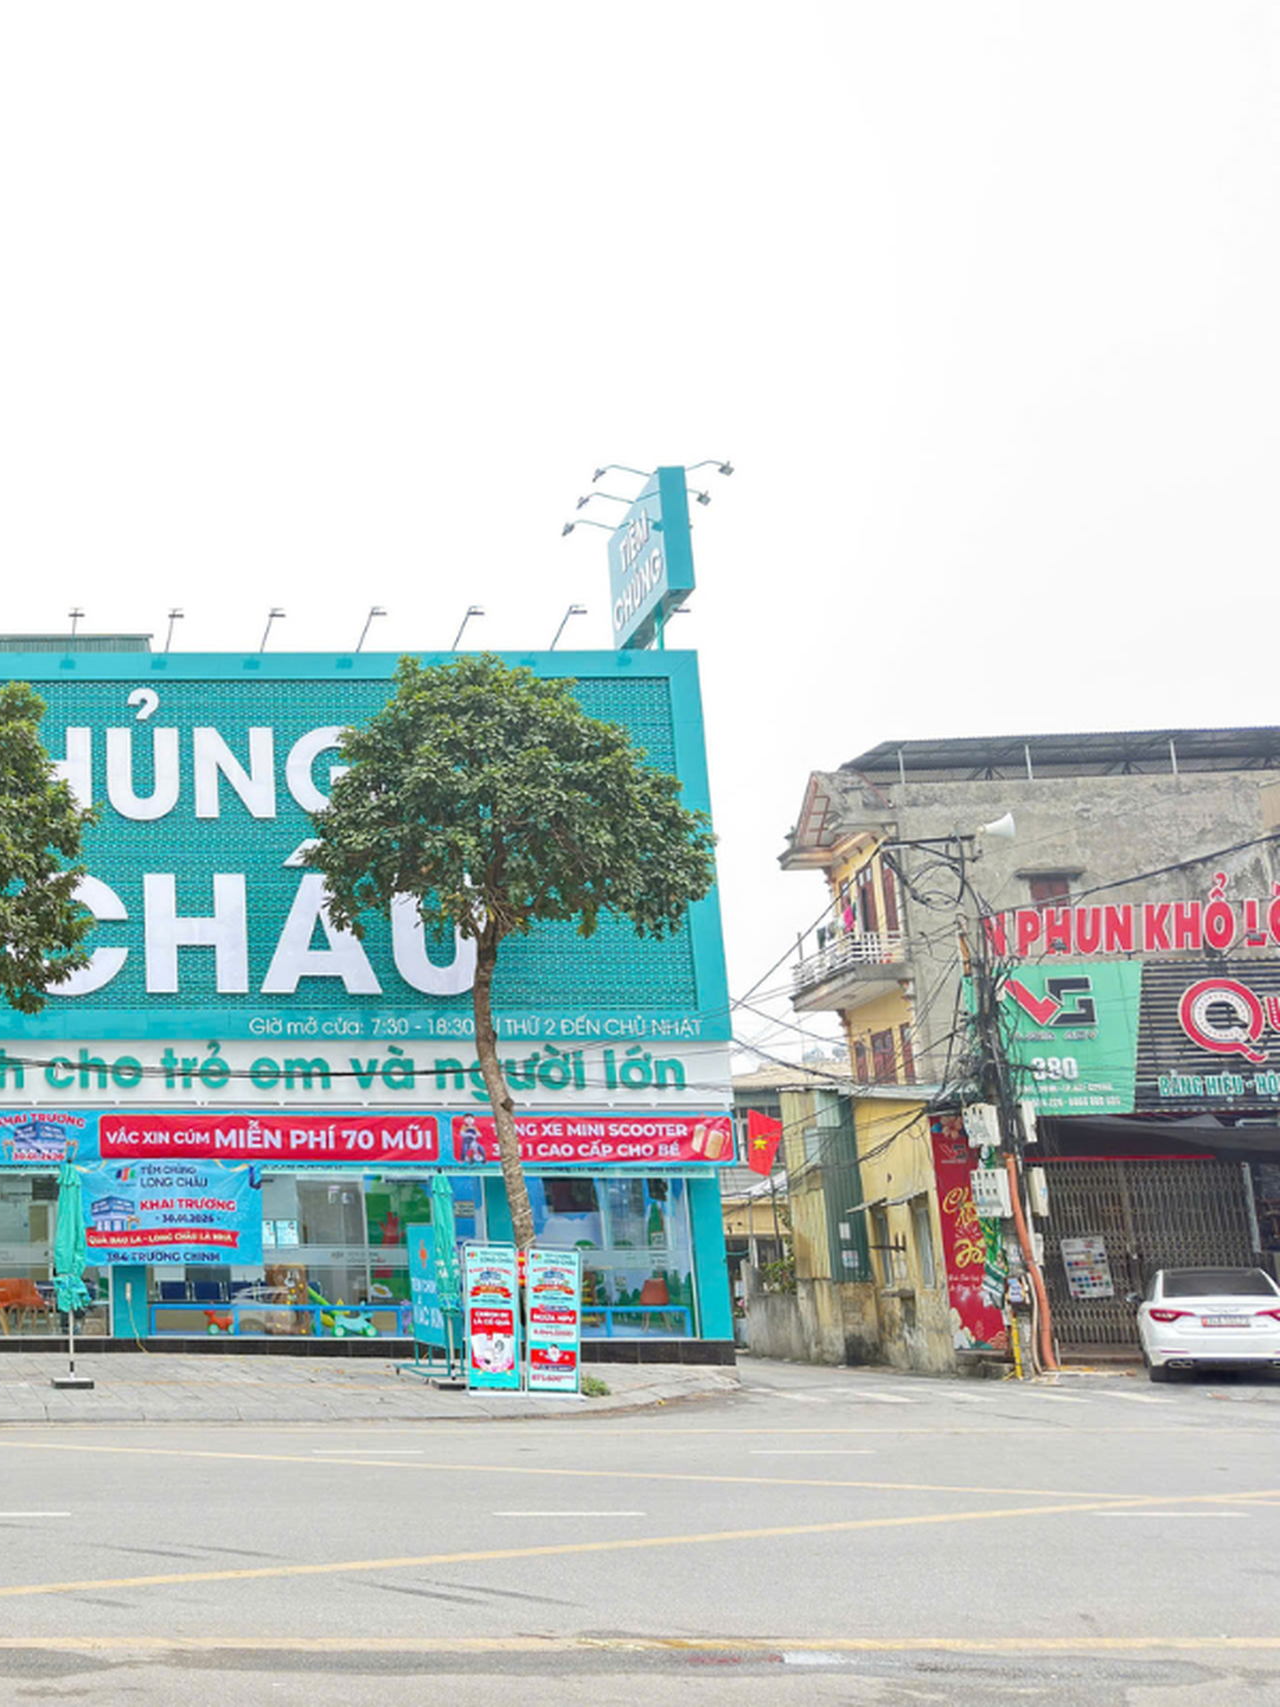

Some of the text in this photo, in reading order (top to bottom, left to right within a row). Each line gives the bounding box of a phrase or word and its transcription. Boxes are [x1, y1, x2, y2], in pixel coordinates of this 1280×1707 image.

[46, 688, 360, 820] HỦNG
[1016, 905, 1135, 957] PHUN
[1144, 872, 1236, 954] KHỔ
[249, 1016, 283, 1035] Giờ
[287, 1016, 318, 1035] mở
[322, 1017, 365, 1035] cửa:
[372, 1019, 409, 1035] 7:30
[428, 1019, 475, 1035] 18:30
[504, 1014, 540, 1036] THỨ
[545, 1019, 556, 1036] 2
[561, 1013, 600, 1036] ĐẾN
[604, 1015, 646, 1036] CHỦ
[651, 1015, 704, 1038] NHẬT
[45, 1048, 143, 1090] cho
[161, 1040, 230, 1090] trẻ
[249, 1055, 331, 1090] em
[349, 1045, 415, 1090] và
[434, 1043, 586, 1103] người
[602, 1044, 686, 1091] lớn
[1158, 1070, 1204, 1097] BẢNG
[1205, 1071, 1245, 1103] HIỆU
[142, 1131, 171, 1145] XIN
[173, 1128, 211, 1145] CÚM
[214, 1120, 283, 1150] MIỄN
[288, 1124, 337, 1150] PHÍ
[341, 1130, 375, 1150] 70
[380, 1124, 434, 1150] MŨI
[540, 1123, 564, 1137] XE
[567, 1123, 605, 1137] MINI
[608, 1123, 688, 1137] SCOOTER
[537, 1142, 575, 1158] CAO
[577, 1139, 614, 1158] CẤP
[616, 1142, 655, 1157] CHO
[657, 1140, 681, 1157] BÉ
[140, 1198, 176, 1211] KHAI
